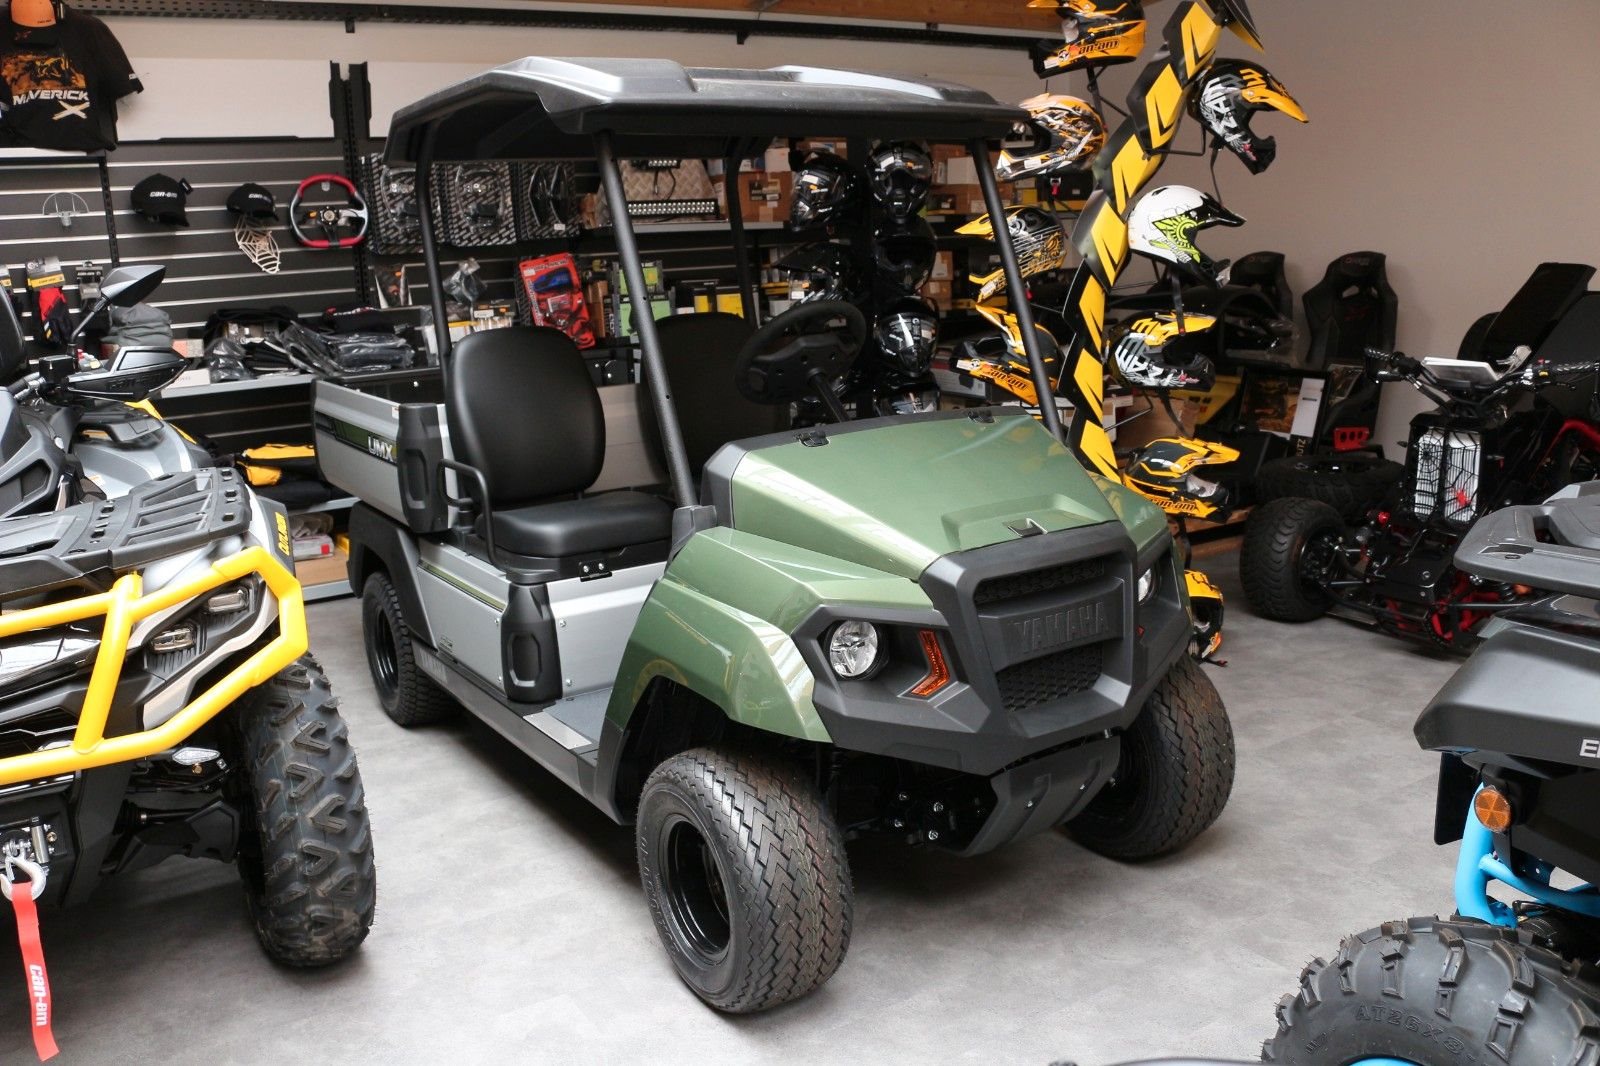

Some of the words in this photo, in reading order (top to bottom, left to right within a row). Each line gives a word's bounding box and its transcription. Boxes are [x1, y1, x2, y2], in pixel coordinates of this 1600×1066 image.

[1068, 40, 1119, 56] an-am
[13, 89, 90, 106] MAVERICK
[51, 99, 91, 121] X
[149, 190, 178, 198] can-am
[984, 367, 1029, 390] an-am
[367, 435, 394, 463] UMX
[1151, 498, 1197, 512] an-am
[1012, 602, 1108, 654] YAMAHA
[1579, 738, 1600, 759] E
[29, 963, 49, 1027] can-am
